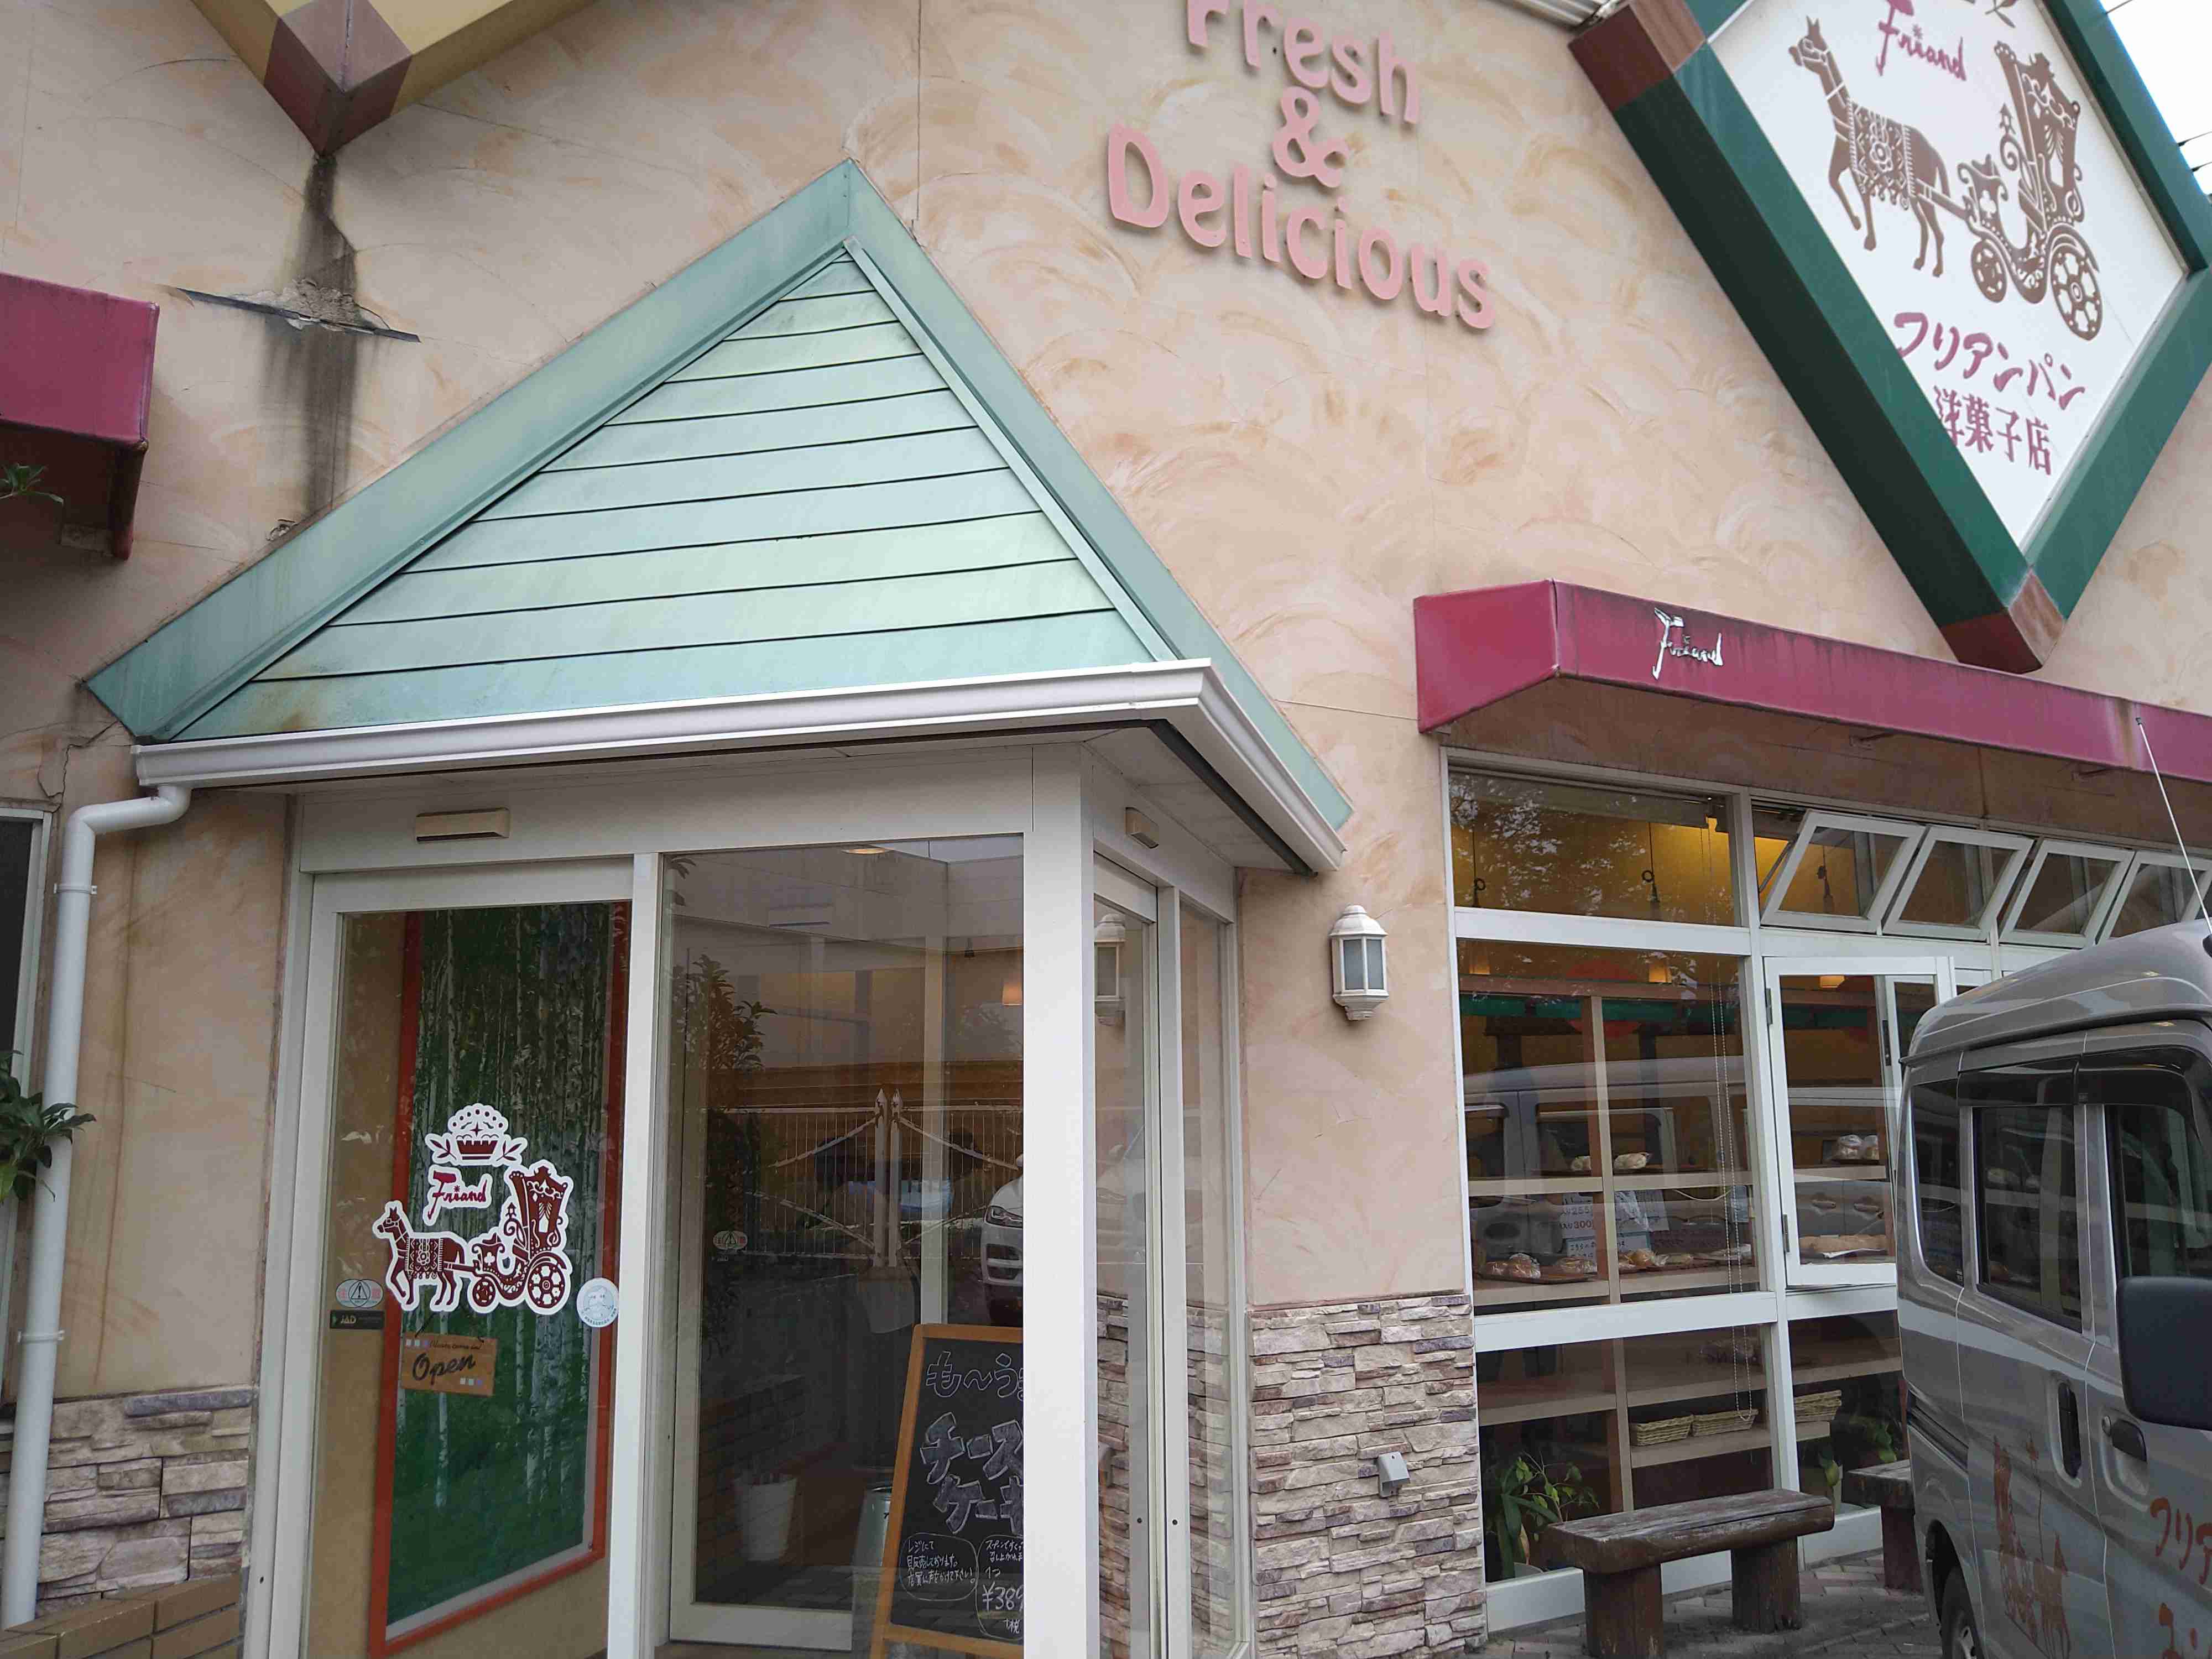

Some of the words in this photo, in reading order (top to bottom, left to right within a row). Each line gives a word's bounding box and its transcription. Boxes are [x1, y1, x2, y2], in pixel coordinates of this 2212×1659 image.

[1272, 86, 1349, 188] &
[1108, 123, 1494, 328] Delicious
[1893, 312, 2085, 410] フリアンパン
[1933, 385, 2051, 476] 洋菓子店
[427, 1170, 487, 1220] Friand
[413, 1353, 476, 1385] Open
